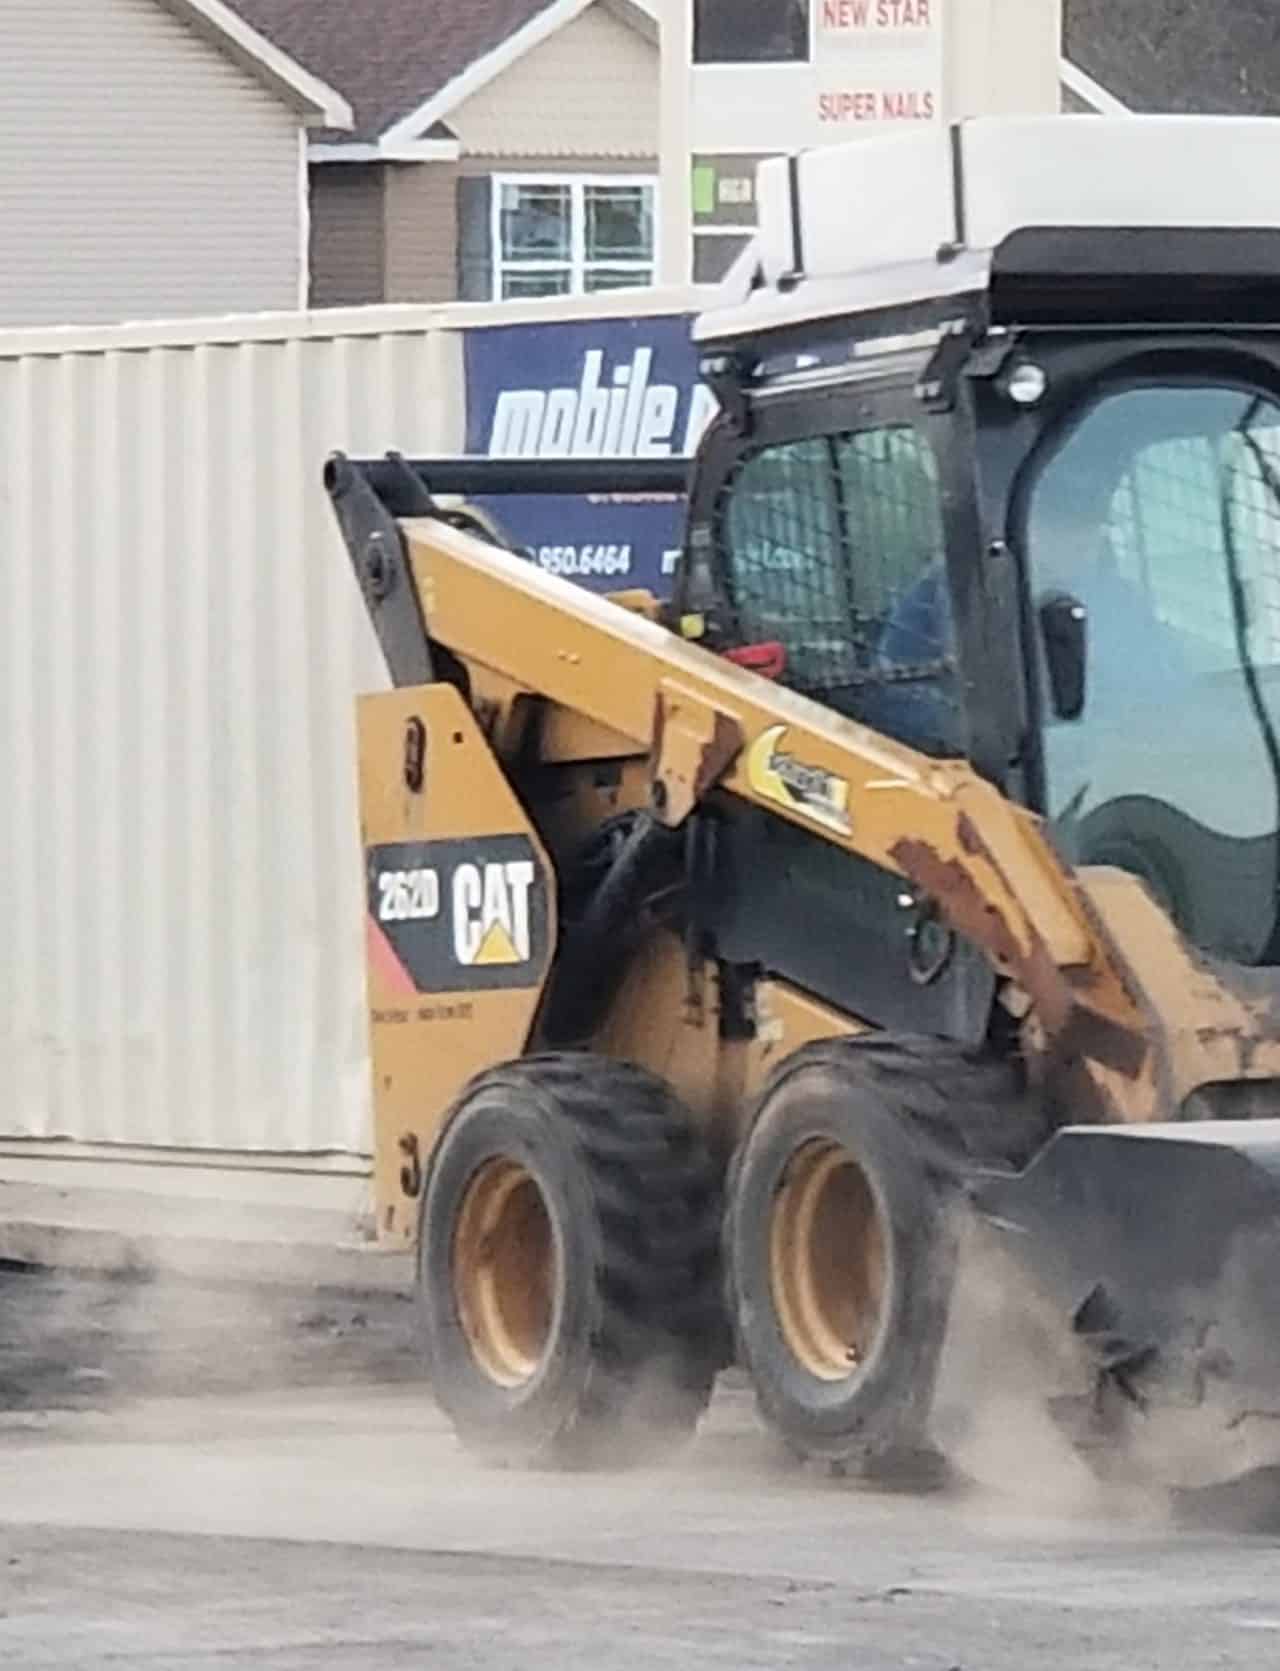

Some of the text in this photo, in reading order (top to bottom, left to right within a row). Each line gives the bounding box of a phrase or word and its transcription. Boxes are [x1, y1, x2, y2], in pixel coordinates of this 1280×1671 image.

[824, 0, 930, 27] NEW STAR
[819, 91, 934, 121] SUPER NAILS
[488, 347, 678, 458] mobile
[527, 545, 631, 575] 950.6464
[452, 861, 533, 965] CAT
